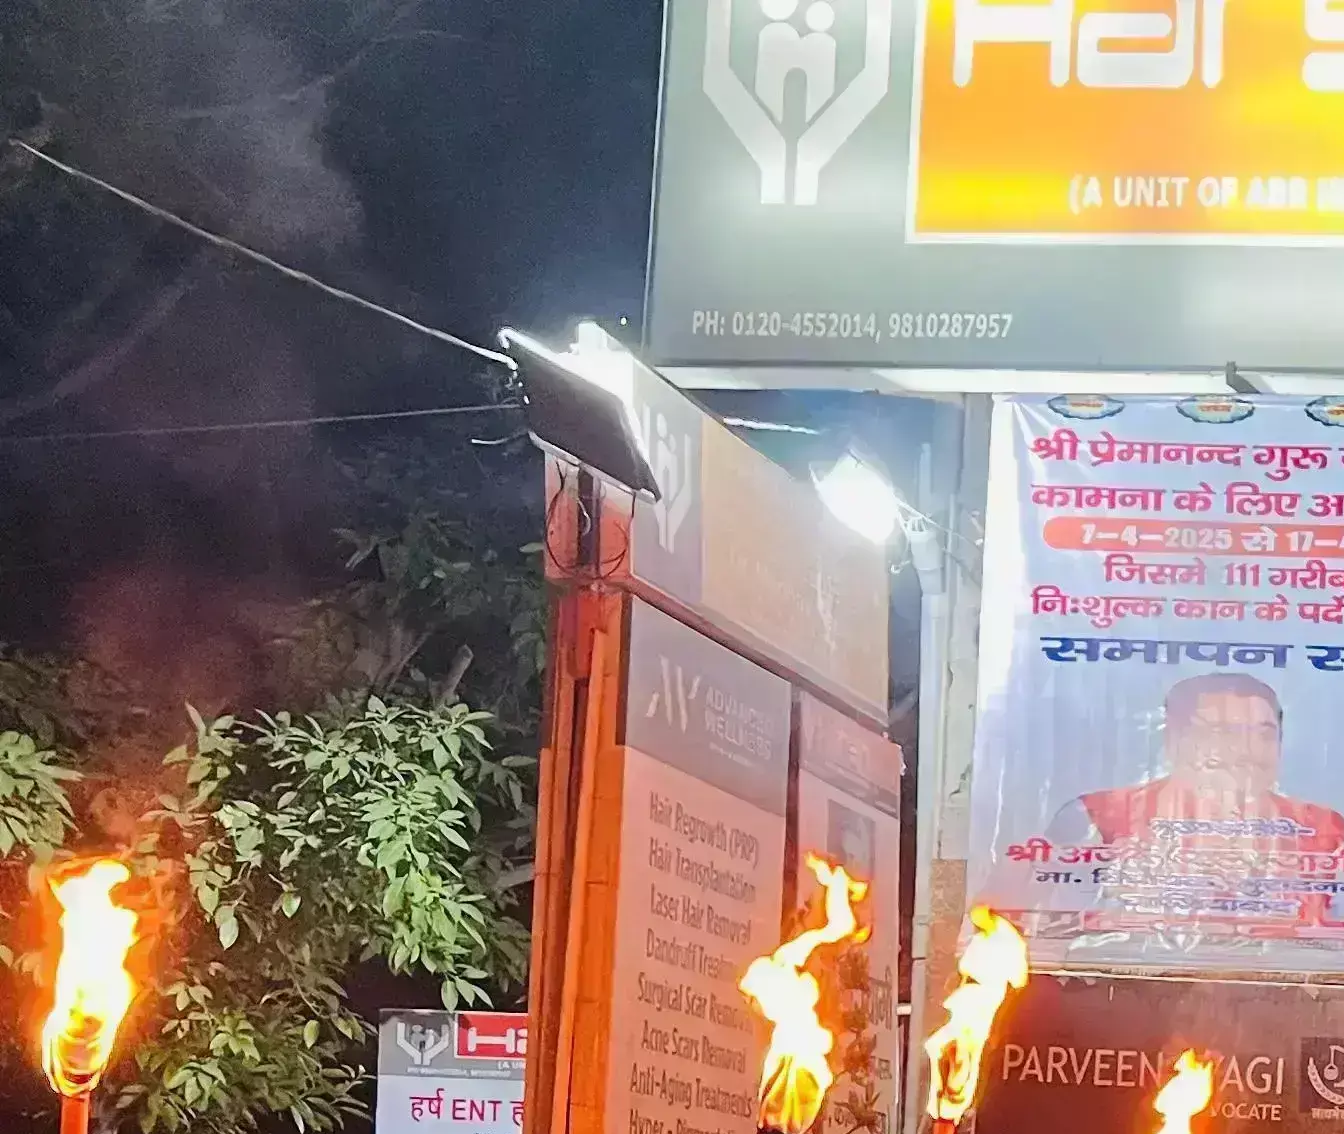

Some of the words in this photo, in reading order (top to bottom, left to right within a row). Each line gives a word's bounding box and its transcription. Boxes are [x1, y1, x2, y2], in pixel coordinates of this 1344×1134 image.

[1069, 176, 1103, 214] (A
[1112, 177, 1191, 210] UNIT
[1197, 178, 1238, 210] OF
[692, 311, 725, 337] PH:
[731, 312, 881, 343] 0120-4552014,
[888, 312, 1013, 340] 9810287957
[1031, 428, 1080, 461] श्री
[1088, 431, 1246, 467] प्रेमानन्द
[1031, 483, 1166, 512] कामना
[1172, 481, 1216, 514] के
[1225, 481, 1302, 518] लिए
[1240, 525, 1279, 552] से
[1225, 562, 1261, 588] 111
[1031, 584, 1167, 628] निःशुल्क
[1172, 596, 1245, 622] कान
[1253, 593, 1290, 623] के
[1040, 636, 1295, 668] समापन
[649, 790, 672, 828] Hair
[674, 802, 727, 852] Regrowth
[649, 836, 672, 873] Hair
[1005, 835, 1053, 864] श्री
[650, 882, 679, 922] Laser
[682, 894, 704, 930] Hair
[706, 904, 752, 946] Removal
[646, 927, 699, 972] Dandruff
[637, 971, 683, 1012] Surgical
[685, 986, 707, 1019] Scar
[641, 1019, 669, 1055] Acne
[672, 1027, 699, 1062] Scars
[702, 1035, 747, 1074] Removal
[1001, 1043, 1164, 1089] PARVEEN
[409, 1088, 444, 1122] हर्ष
[452, 1100, 502, 1122] ENT
[630, 1062, 693, 1110] Anti-Aging
